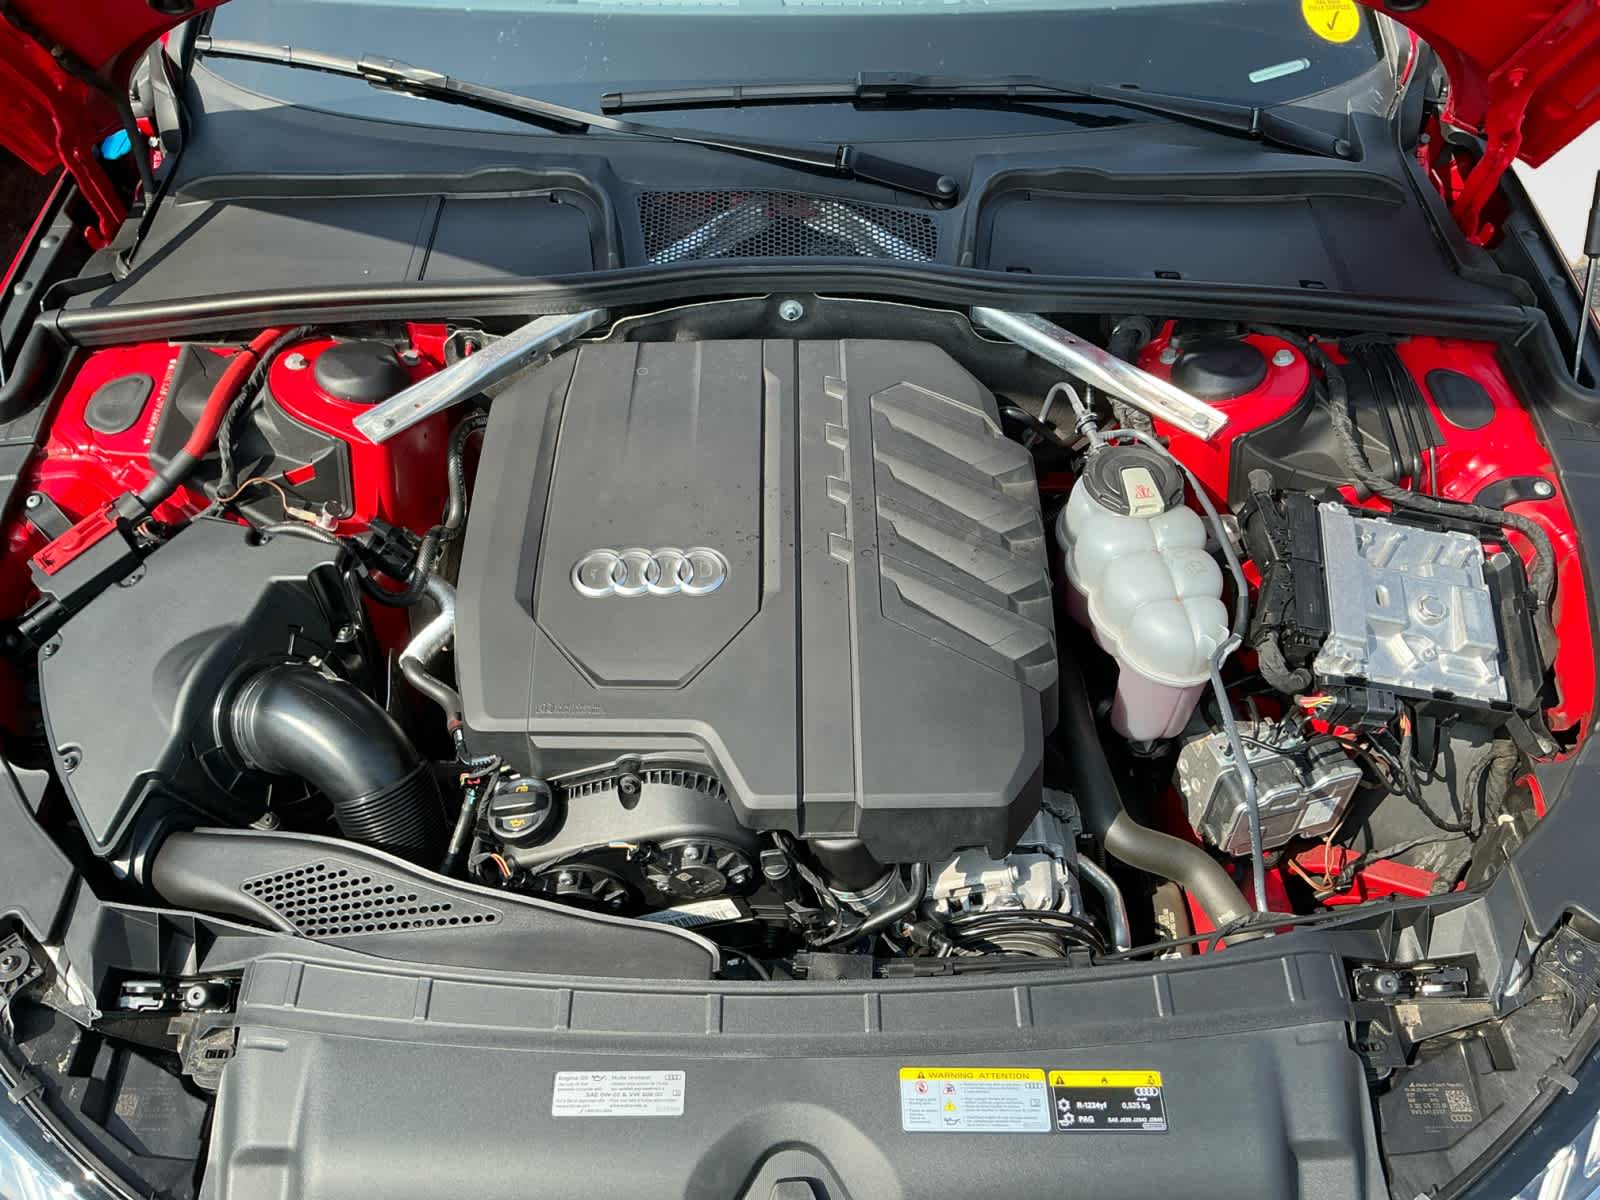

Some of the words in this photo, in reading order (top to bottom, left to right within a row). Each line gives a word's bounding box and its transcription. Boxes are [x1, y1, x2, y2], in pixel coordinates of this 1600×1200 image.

[1076, 1101, 1107, 1110] R-1234yf
[1141, 1101, 1151, 1111] kg
[1077, 1115, 1095, 1123] PAG
